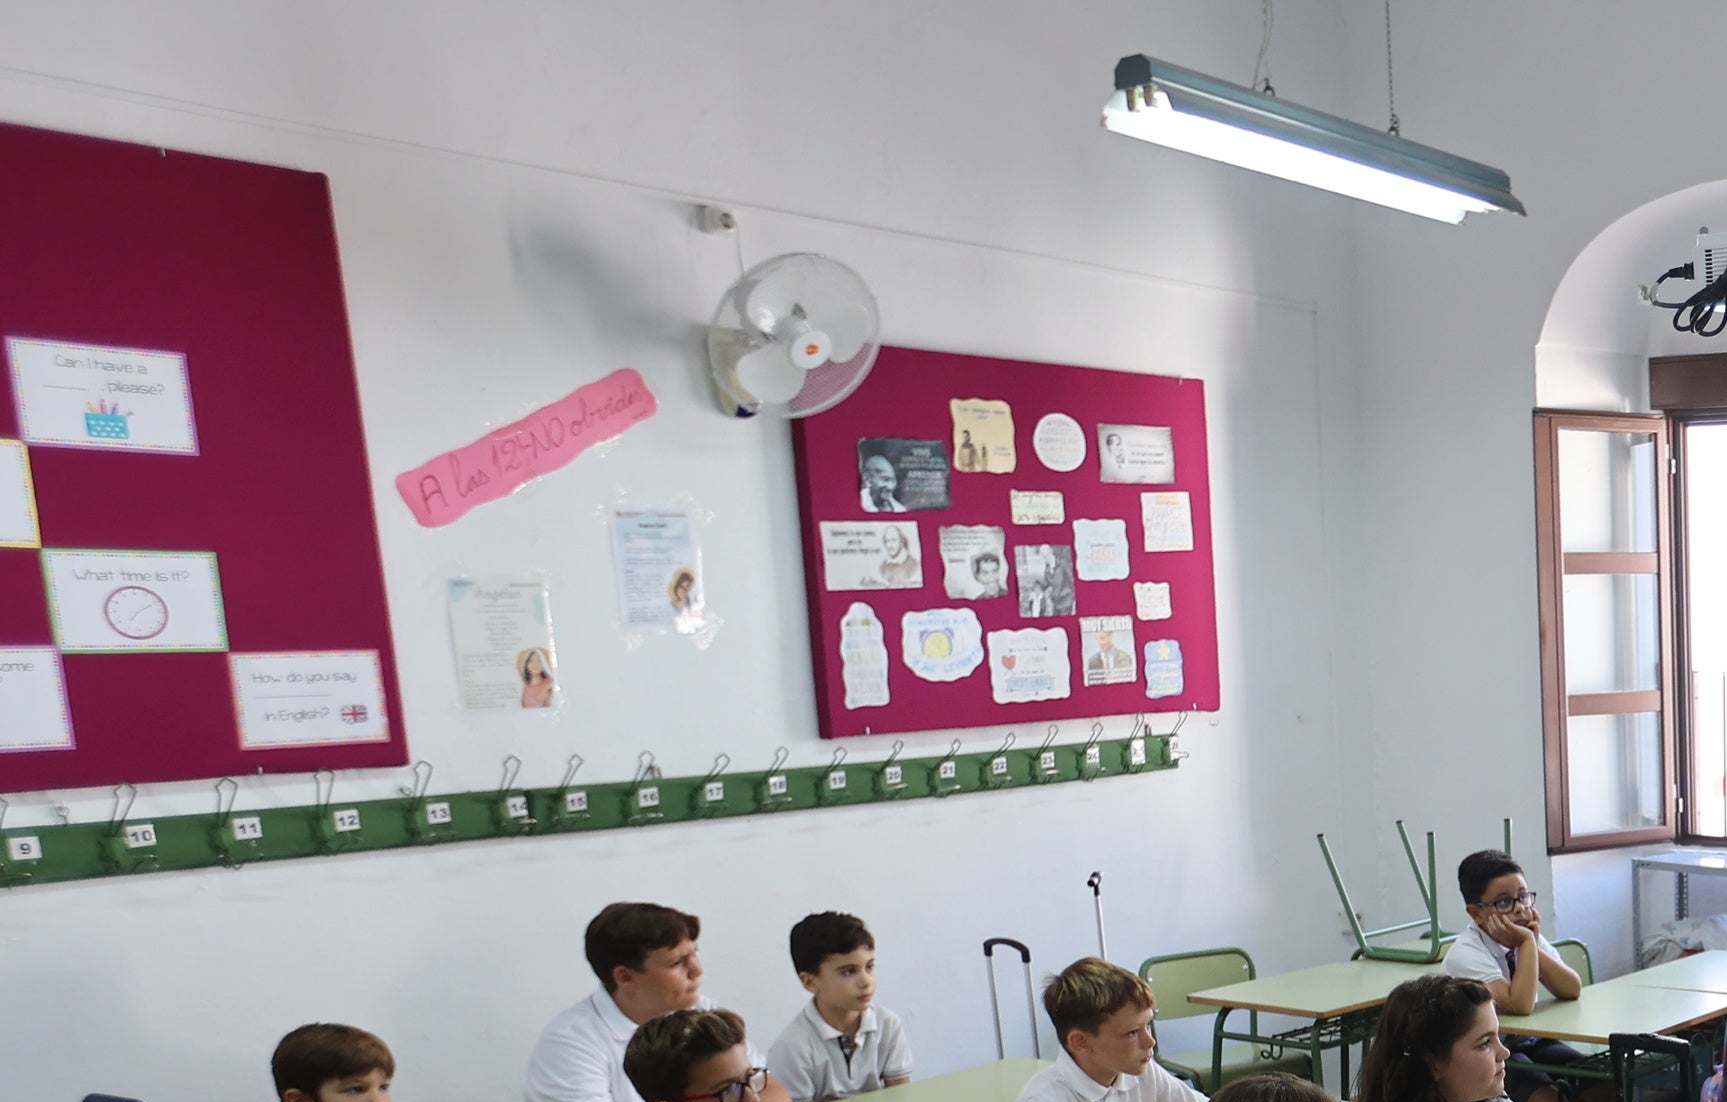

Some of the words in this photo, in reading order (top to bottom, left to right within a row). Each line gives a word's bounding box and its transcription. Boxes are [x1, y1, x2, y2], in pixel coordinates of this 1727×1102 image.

[55, 355, 84, 369] Can
[94, 359, 134, 373] have
[137, 365, 148, 375] a
[418, 474, 449, 515] A
[448, 452, 491, 498] las
[73, 568, 115, 582] What
[119, 569, 153, 582] time
[155, 570, 169, 582] is
[172, 570, 192, 583] it?
[0, 662, 34, 672] ome
[252, 671, 282, 683] How
[286, 671, 303, 683] do
[306, 674, 331, 685] you
[333, 671, 358, 684] say
[887, 771, 900, 780] 20
[941, 765, 954, 775] 21
[831, 775, 845, 786] 19
[642, 792, 658, 803] 16
[707, 786, 722, 797] 17
[569, 796, 585, 808] 15
[430, 806, 447, 819] 13
[338, 814, 359, 827] 12
[238, 822, 258, 836] 11
[130, 829, 152, 843] 10
[19, 843, 32, 855] 9
